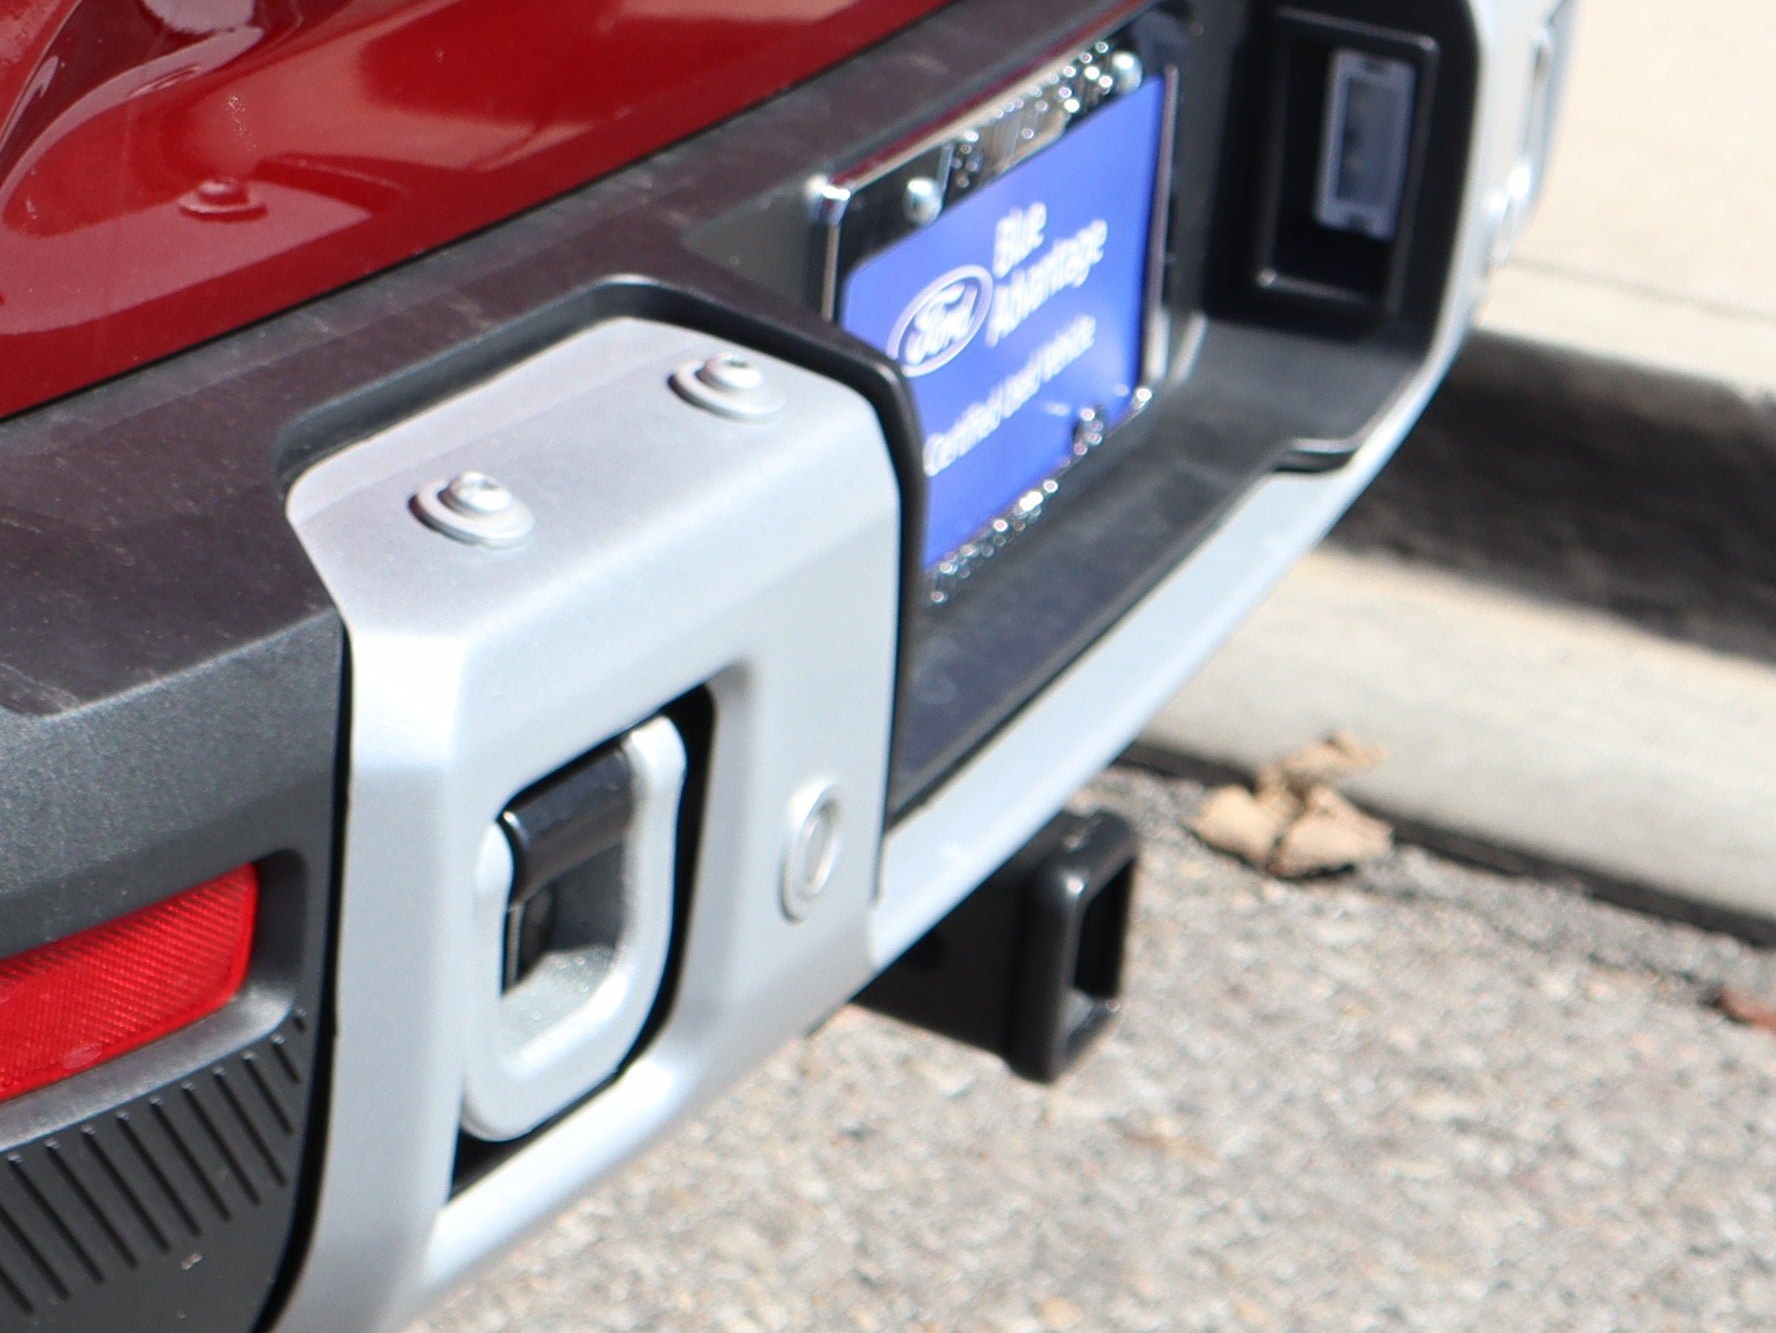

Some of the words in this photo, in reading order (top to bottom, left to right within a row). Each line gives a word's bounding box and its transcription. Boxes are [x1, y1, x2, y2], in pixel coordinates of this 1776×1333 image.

[985, 218, 1108, 347] Advantage
[993, 201, 1047, 279] Blue
[904, 282, 978, 365] Ford
[923, 385, 1003, 477] Certified
